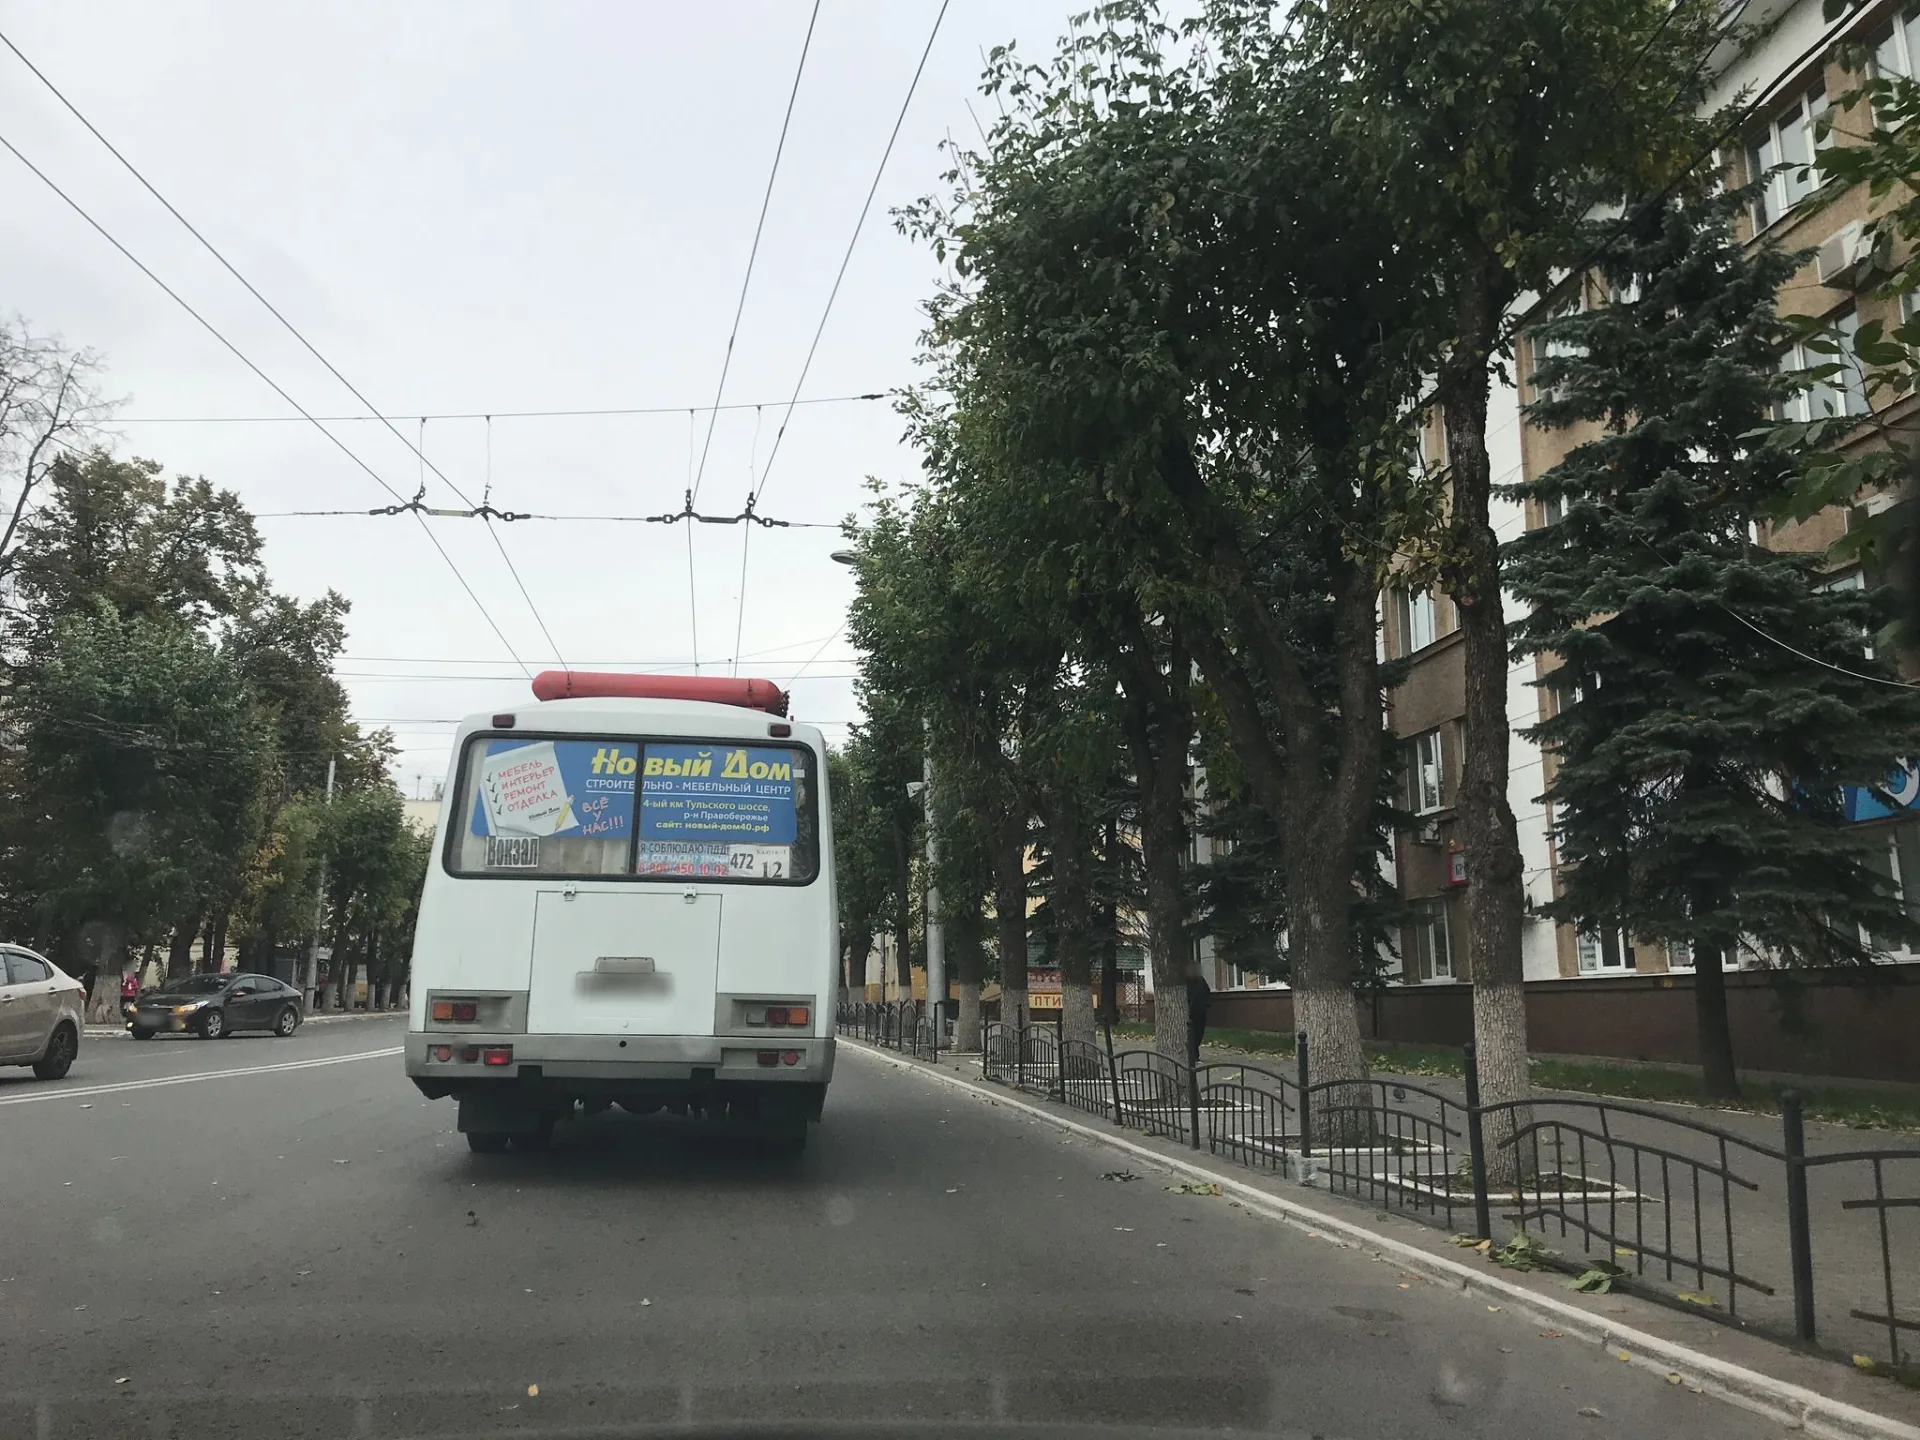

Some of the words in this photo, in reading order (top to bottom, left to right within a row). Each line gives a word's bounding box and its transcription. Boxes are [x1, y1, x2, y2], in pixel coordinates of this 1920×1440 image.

[498, 759, 542, 780] МЕБЕЛЬ
[591, 748, 712, 777] Новый
[721, 749, 791, 781] Дом
[501, 766, 555, 790] ИНТЕРЬЕР
[504, 781, 547, 801] РЕМОНТ
[682, 782, 751, 794] МЕБЕЛЬНЫЙ
[756, 785, 791, 796] ЦЕНТР
[507, 790, 558, 812] ОТДЕЛКА
[643, 800, 668, 808] 4-ый
[670, 801, 683, 809] км
[686, 800, 735, 811] Тульского
[582, 815, 624, 835] НАС!!!
[592, 811, 602, 823] У
[683, 812, 699, 821] р-н
[700, 812, 768, 823] Правобережье
[656, 821, 682, 829] сайт:
[685, 822, 770, 833] новый-дом40.рф
[640, 844, 647, 853] Я
[650, 843, 703, 854] СОБЛЮДАЮ
[730, 853, 754, 870] 472
[762, 860, 783, 878] 12
